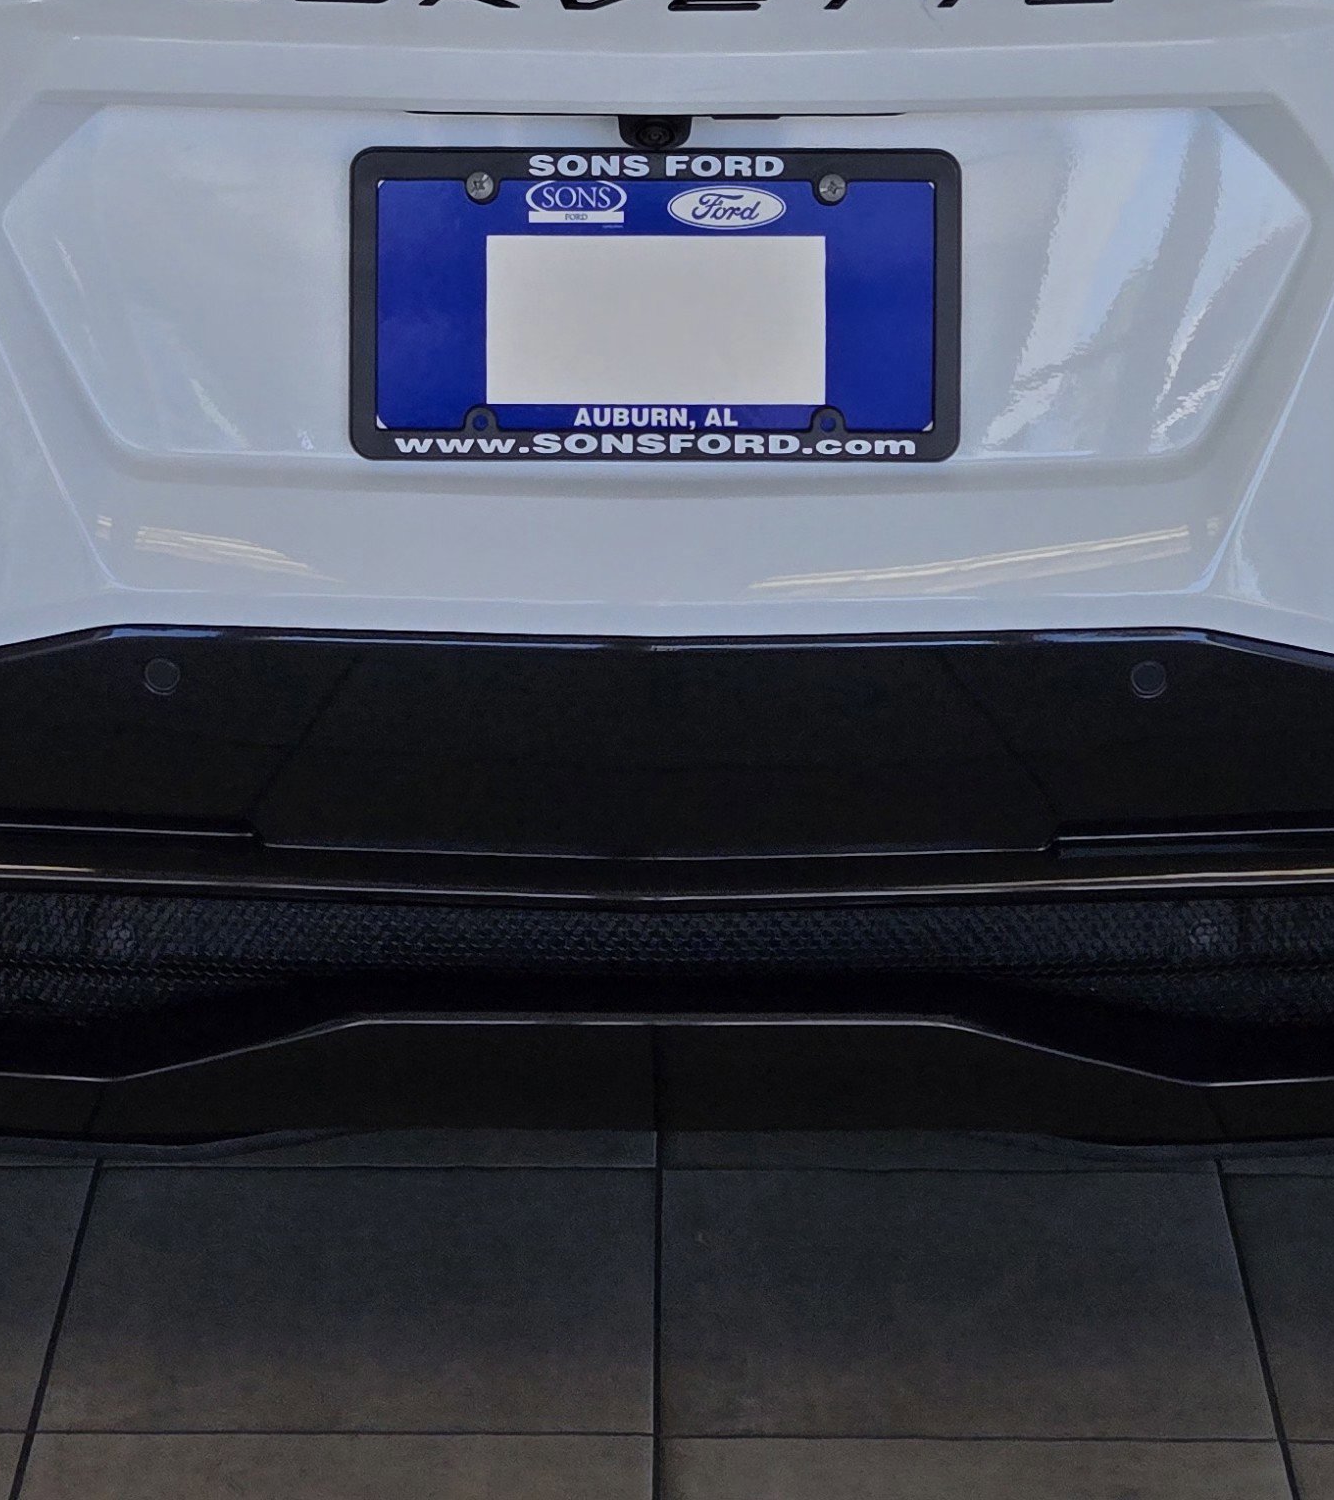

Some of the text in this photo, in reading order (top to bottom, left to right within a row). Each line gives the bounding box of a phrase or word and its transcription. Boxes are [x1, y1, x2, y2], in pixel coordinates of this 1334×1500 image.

[528, 154, 785, 177] SONS FORD
[541, 186, 611, 209] SONS
[691, 192, 762, 221] Ford
[564, 213, 588, 221] FORD
[573, 407, 739, 430] AUBURN, AL
[394, 433, 916, 456] www.SONSFORD.com
